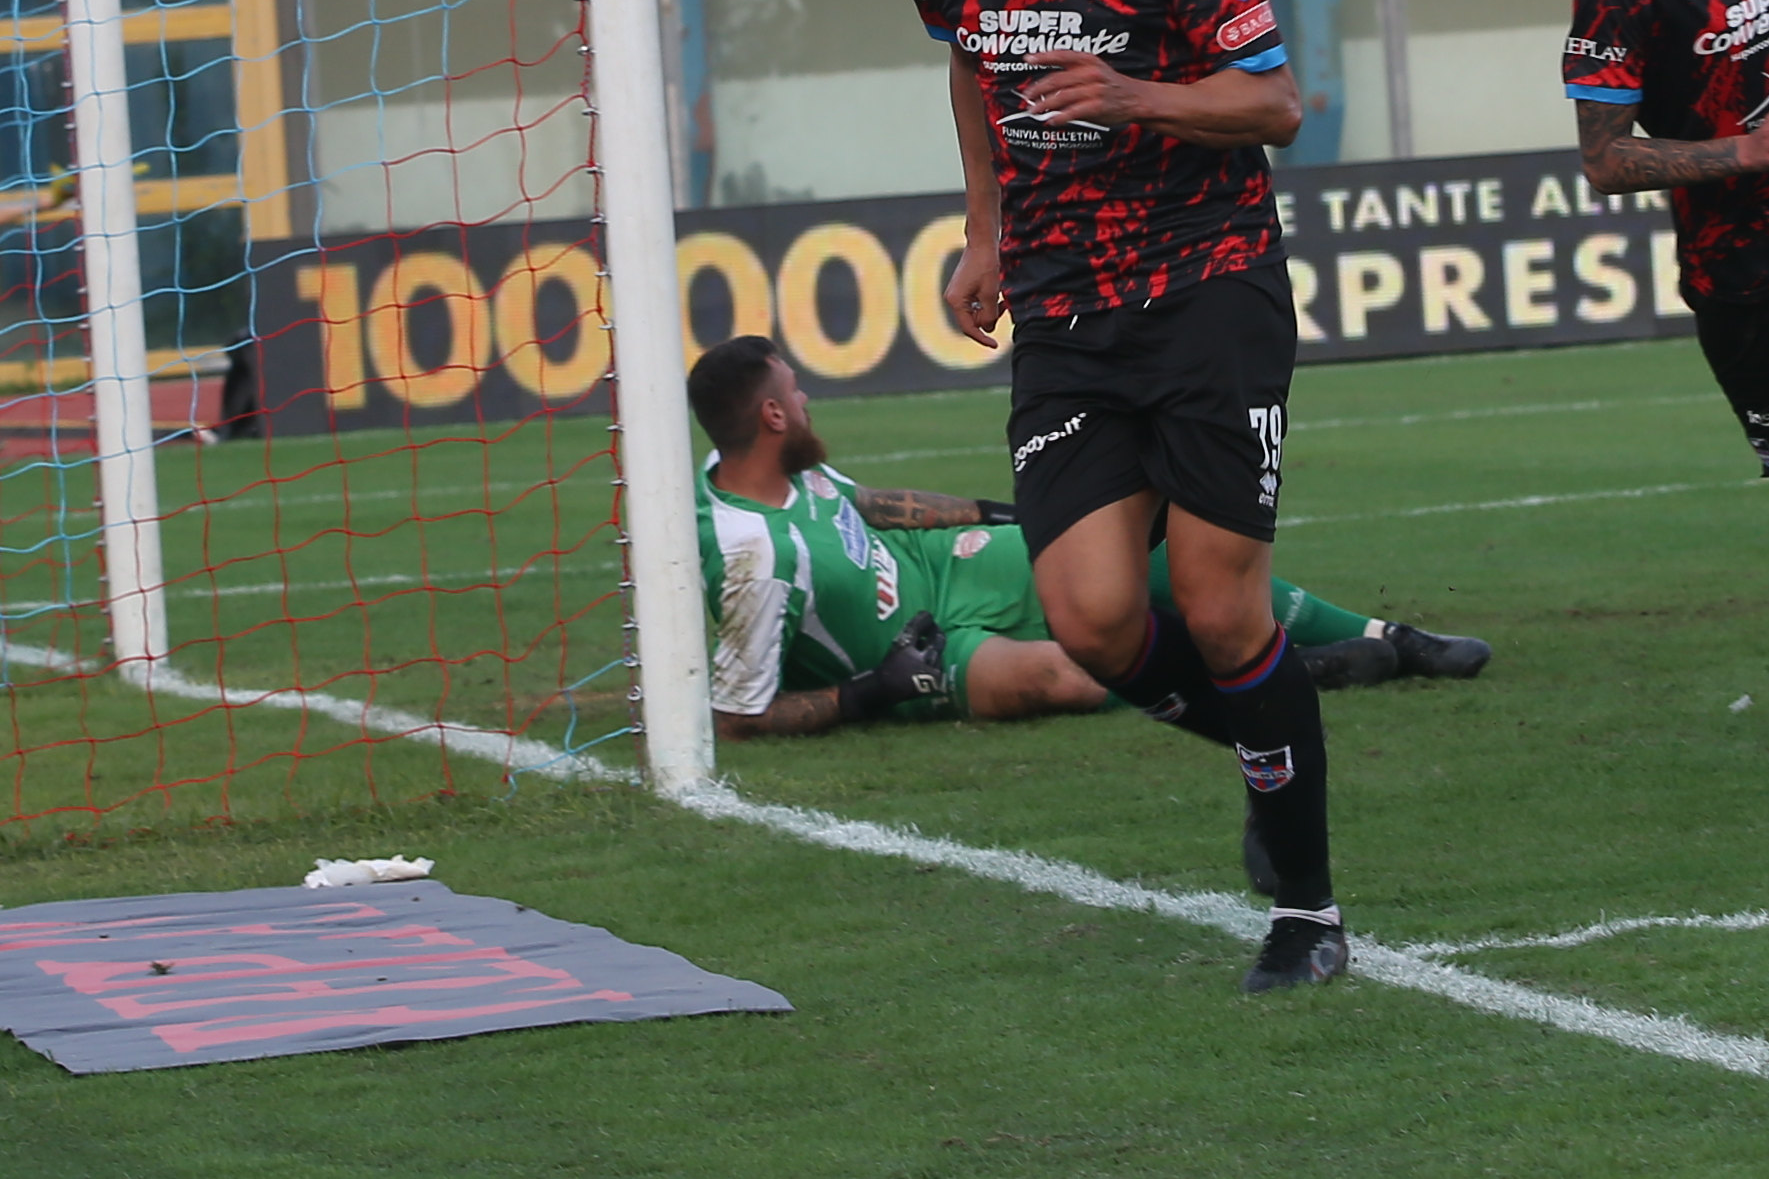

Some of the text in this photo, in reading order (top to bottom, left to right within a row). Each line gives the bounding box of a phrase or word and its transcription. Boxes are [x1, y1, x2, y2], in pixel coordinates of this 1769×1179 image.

[979, 10, 1083, 35] SUPER
[956, 26, 1130, 56] Conveniente
[1563, 37, 1628, 63] EPLAY
[1002, 126, 1101, 142] FUNIVIA DELL'ETNA
[1322, 178, 1504, 232] TANTE
[1249, 404, 1282, 470] 79
